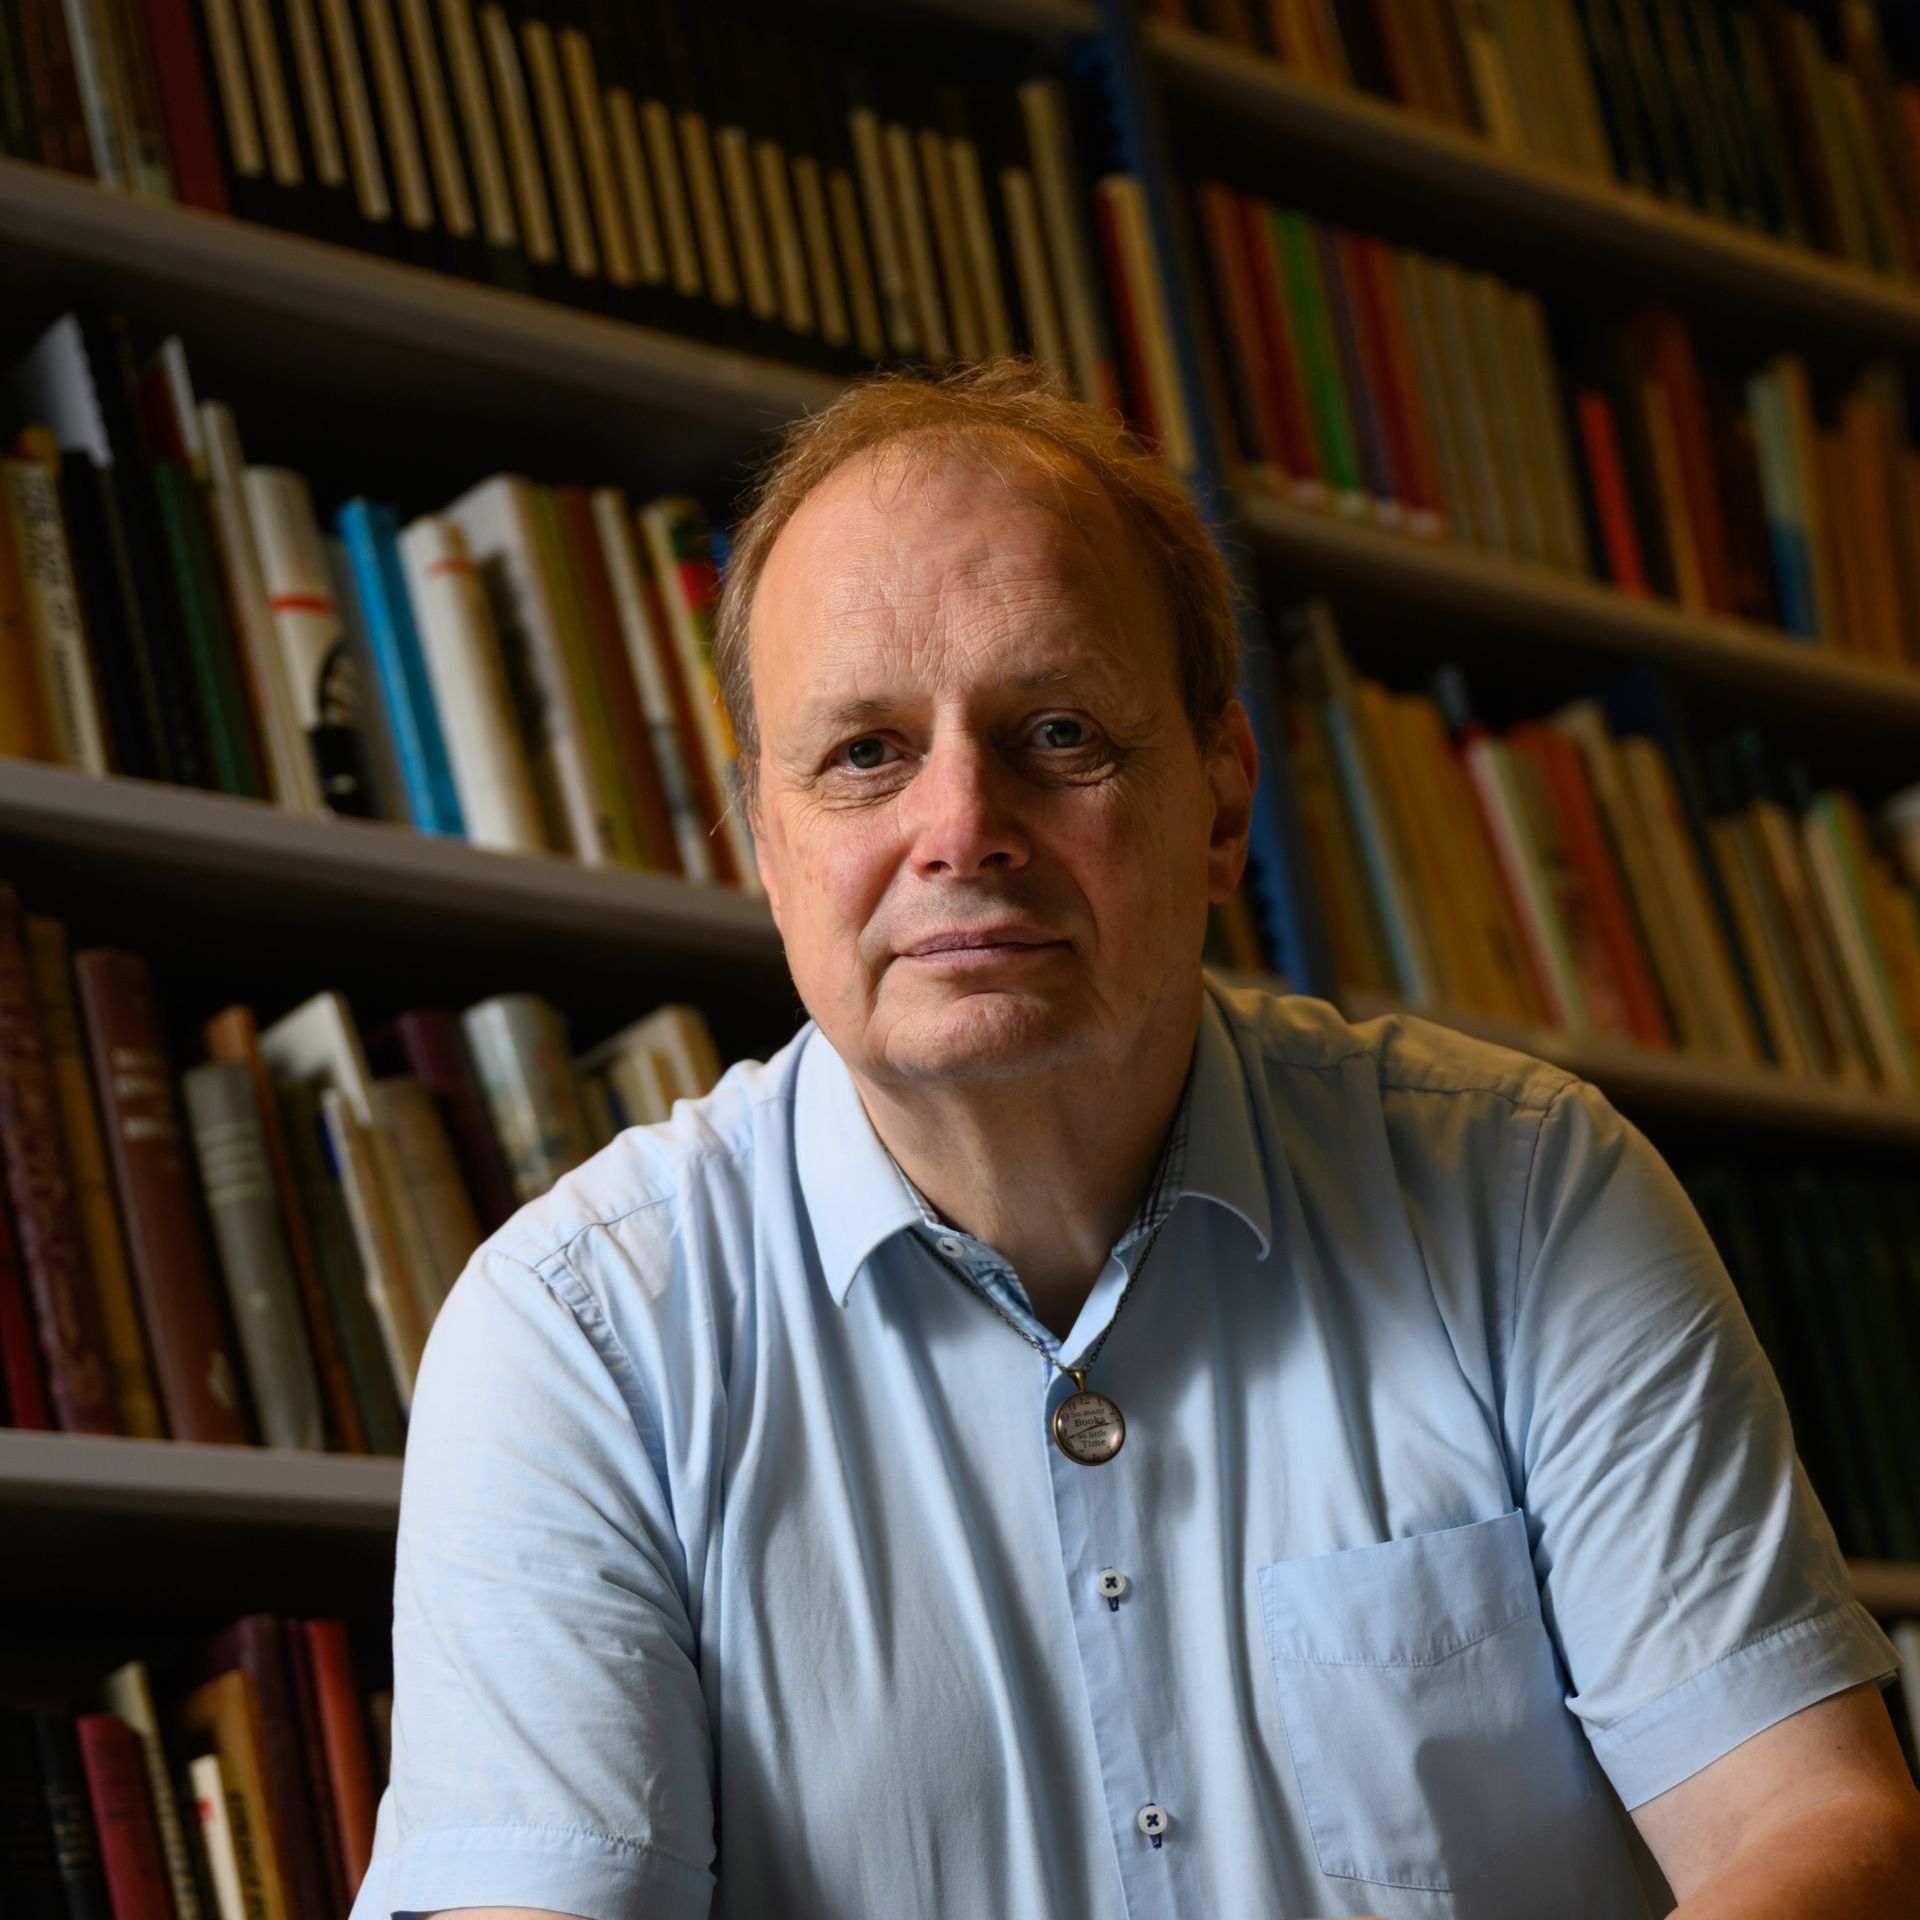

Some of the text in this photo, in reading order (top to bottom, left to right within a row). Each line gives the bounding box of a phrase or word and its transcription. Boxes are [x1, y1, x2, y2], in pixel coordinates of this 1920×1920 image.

[1074, 1416, 1106, 1427] Books
[1089, 1430, 1106, 1438] little
[1080, 1439, 1107, 1449] Time
